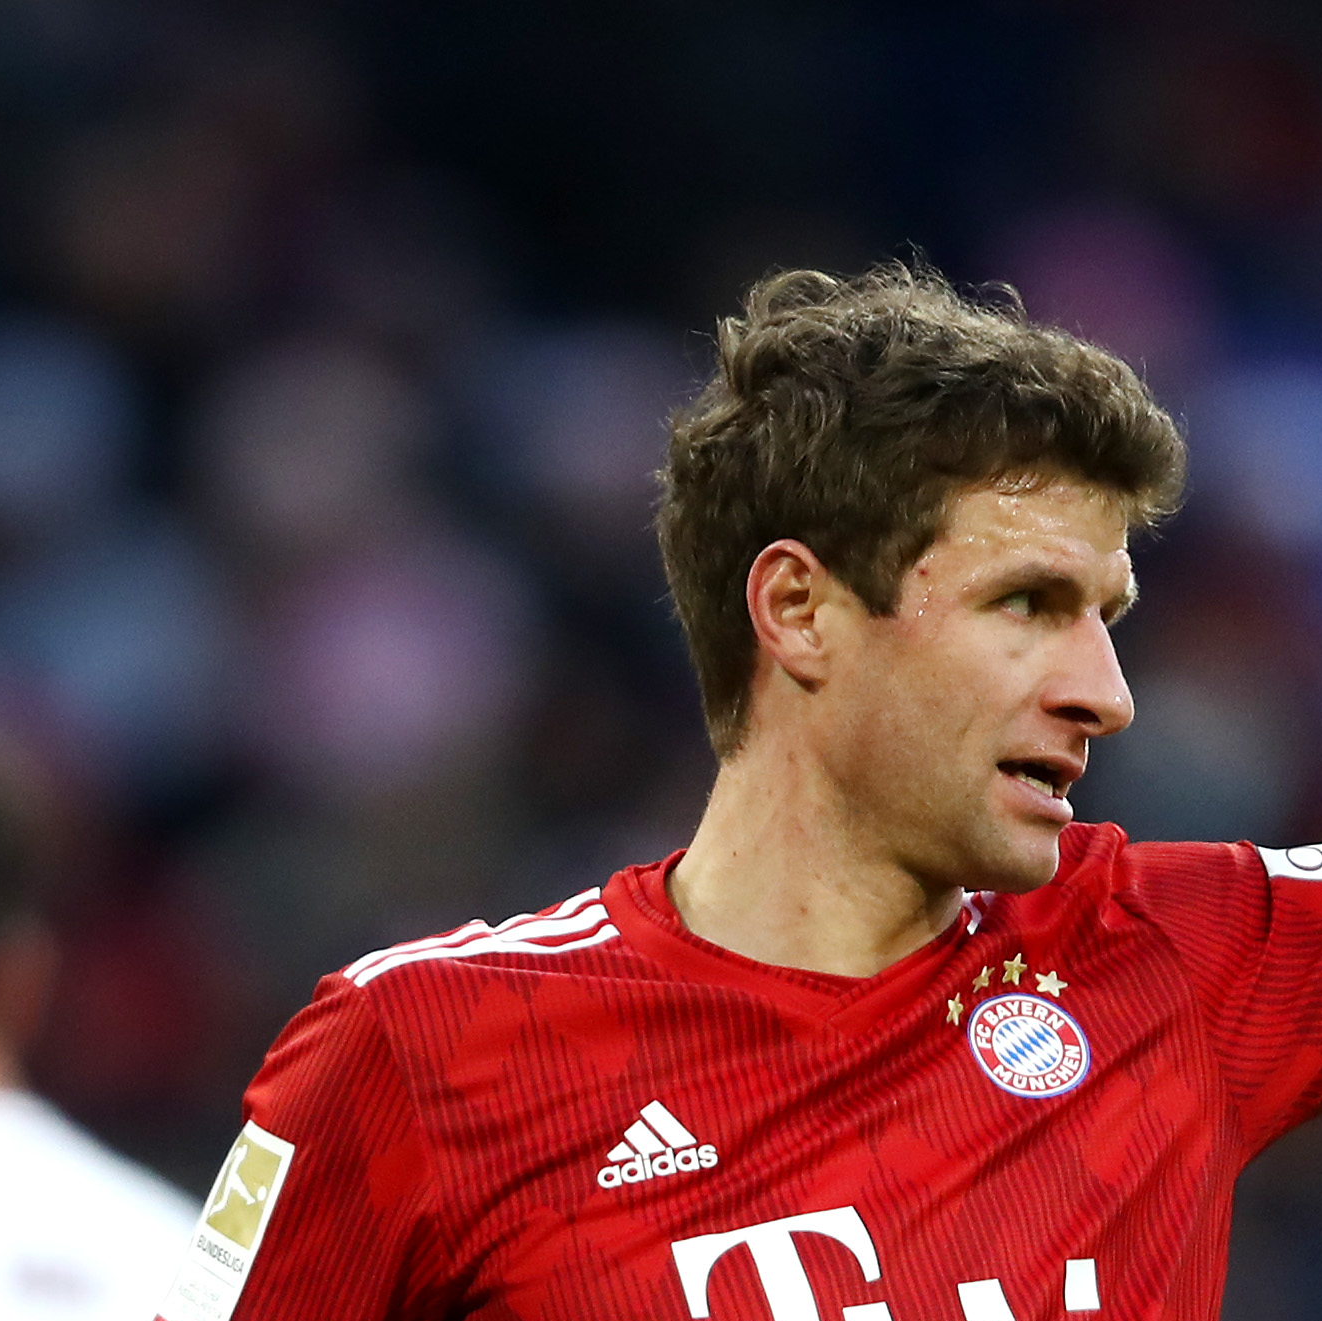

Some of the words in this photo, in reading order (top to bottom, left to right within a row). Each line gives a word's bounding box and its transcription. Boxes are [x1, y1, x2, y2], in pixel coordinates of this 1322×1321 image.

[976, 1023, 992, 1049] FC
[983, 1001, 1065, 1031] BAYERN
[993, 1044, 1081, 1091] MÜNCHEN
[597, 1143, 718, 1188] adidas
[198, 1234, 245, 1274] BUNDESLIGA
